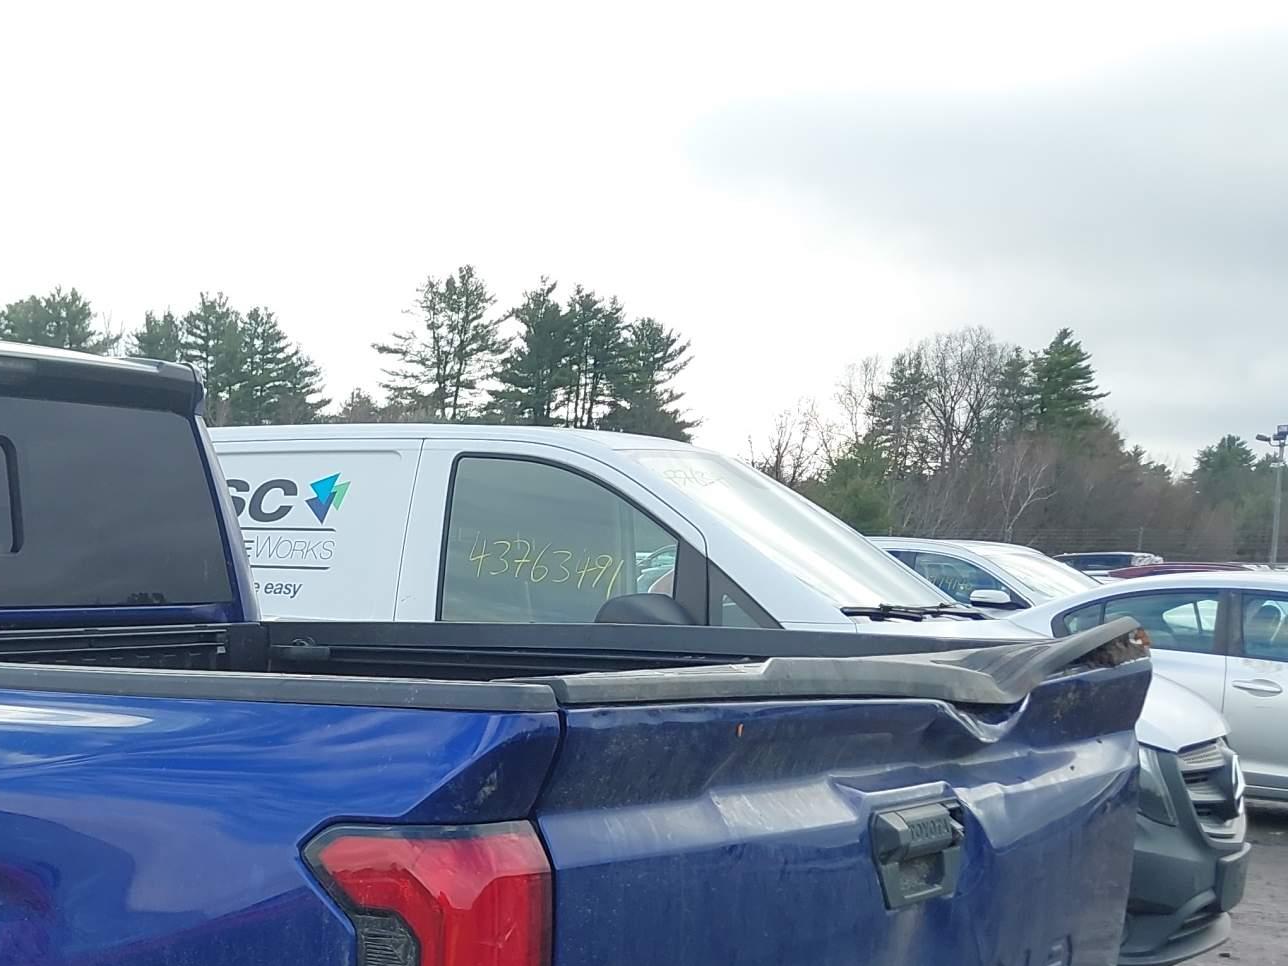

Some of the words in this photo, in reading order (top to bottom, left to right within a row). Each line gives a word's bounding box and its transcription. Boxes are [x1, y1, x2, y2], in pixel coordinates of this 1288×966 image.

[469, 530, 625, 600] 43763491
[264, 581, 303, 599] easy
[908, 818, 953, 841] TOYOTA
